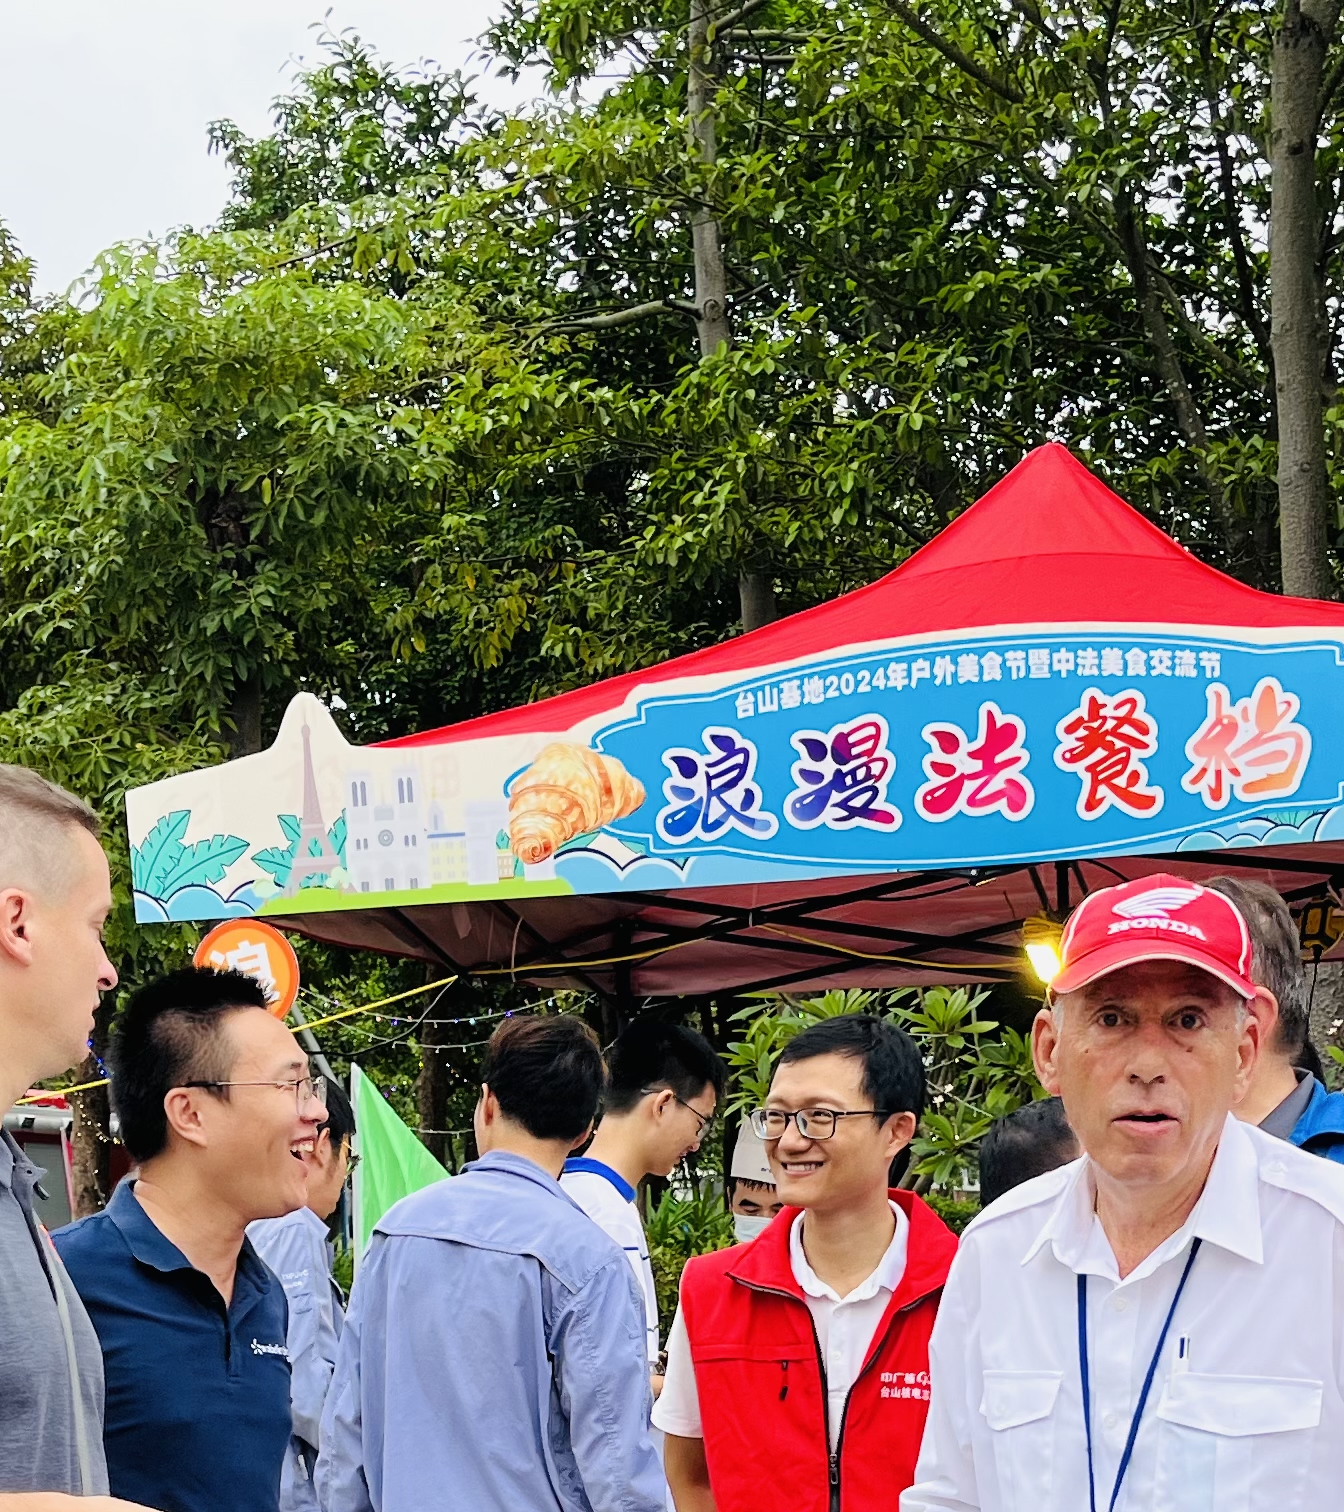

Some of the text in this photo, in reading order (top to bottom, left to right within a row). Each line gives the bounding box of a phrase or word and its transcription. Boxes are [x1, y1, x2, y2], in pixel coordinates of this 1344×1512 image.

[734, 647, 1222, 719] 台山基地2024年户外美食节暨中法美食交流节
[659, 679, 1309, 842] 浪漫法餐档
[1107, 917, 1207, 941] HONDA
